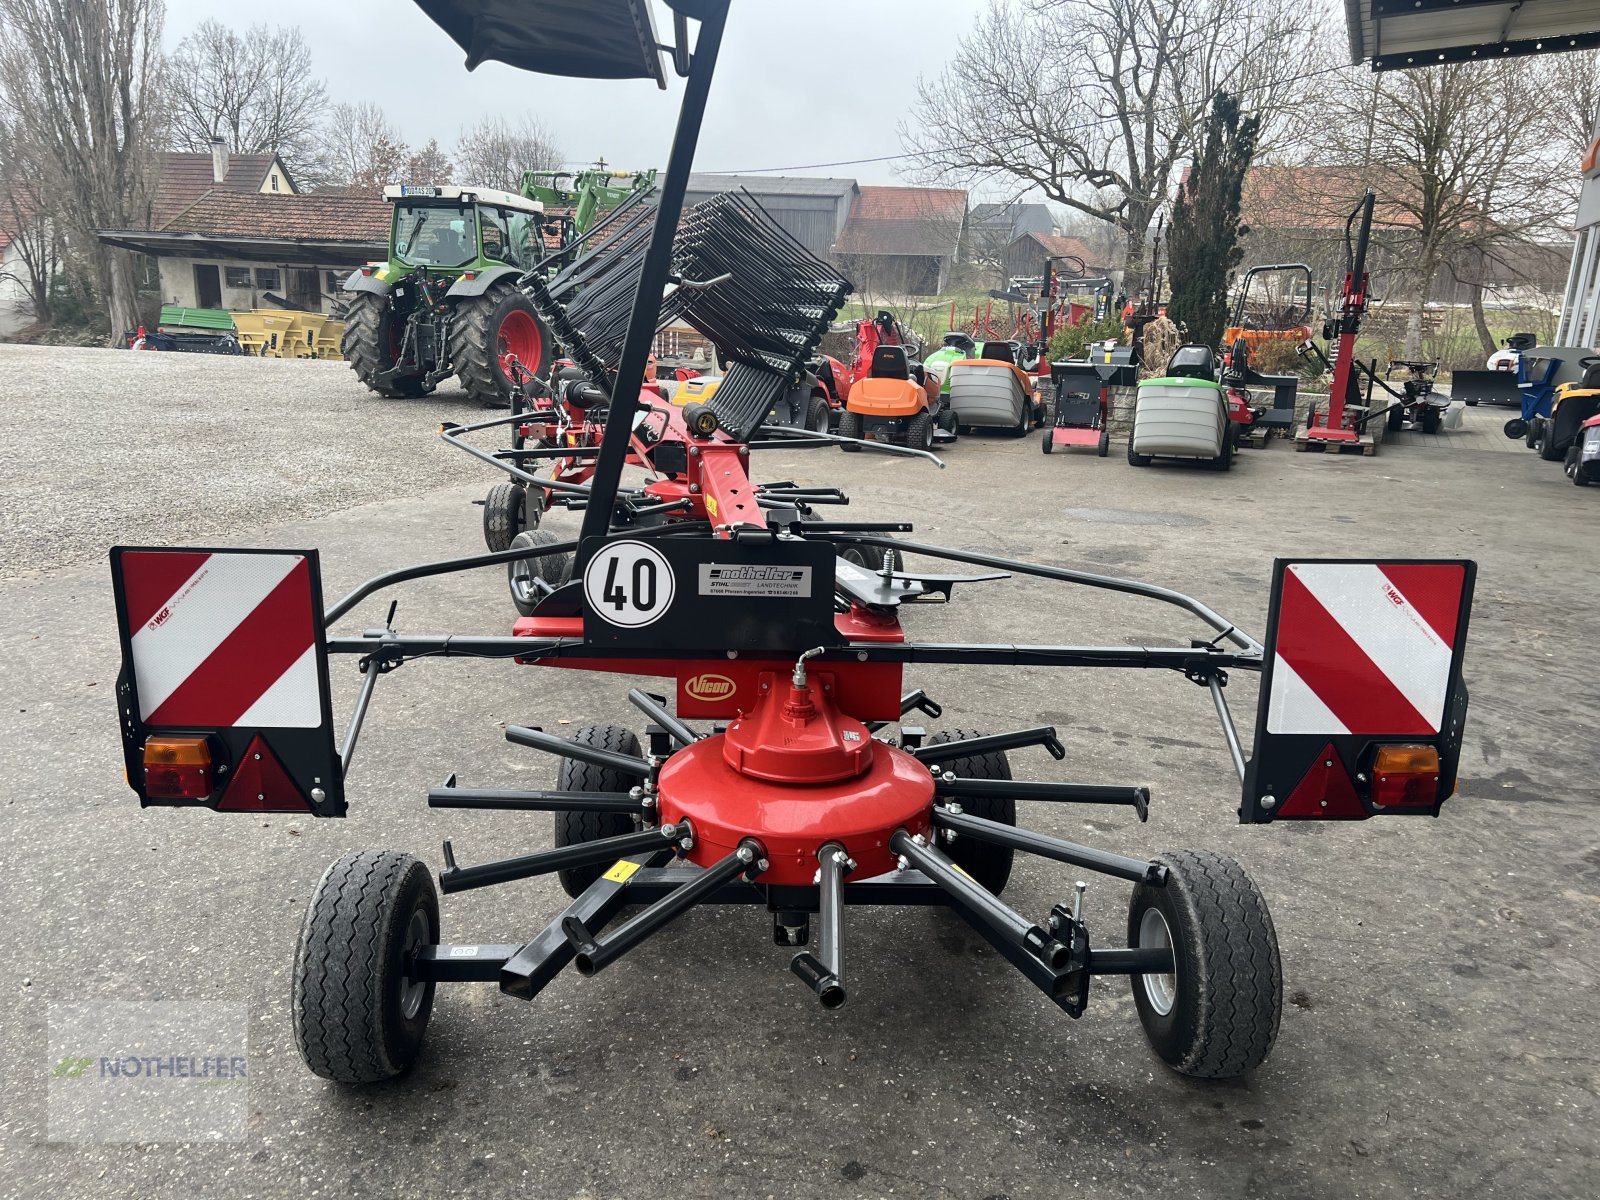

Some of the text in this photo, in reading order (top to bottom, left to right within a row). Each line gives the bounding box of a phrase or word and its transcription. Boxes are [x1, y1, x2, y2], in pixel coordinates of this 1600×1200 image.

[720, 566, 792, 581] nothelfer
[603, 556, 657, 612] 40
[1387, 589, 1405, 606] WGF
[153, 607, 171, 625] WGF
[692, 676, 730, 695] Vicon
